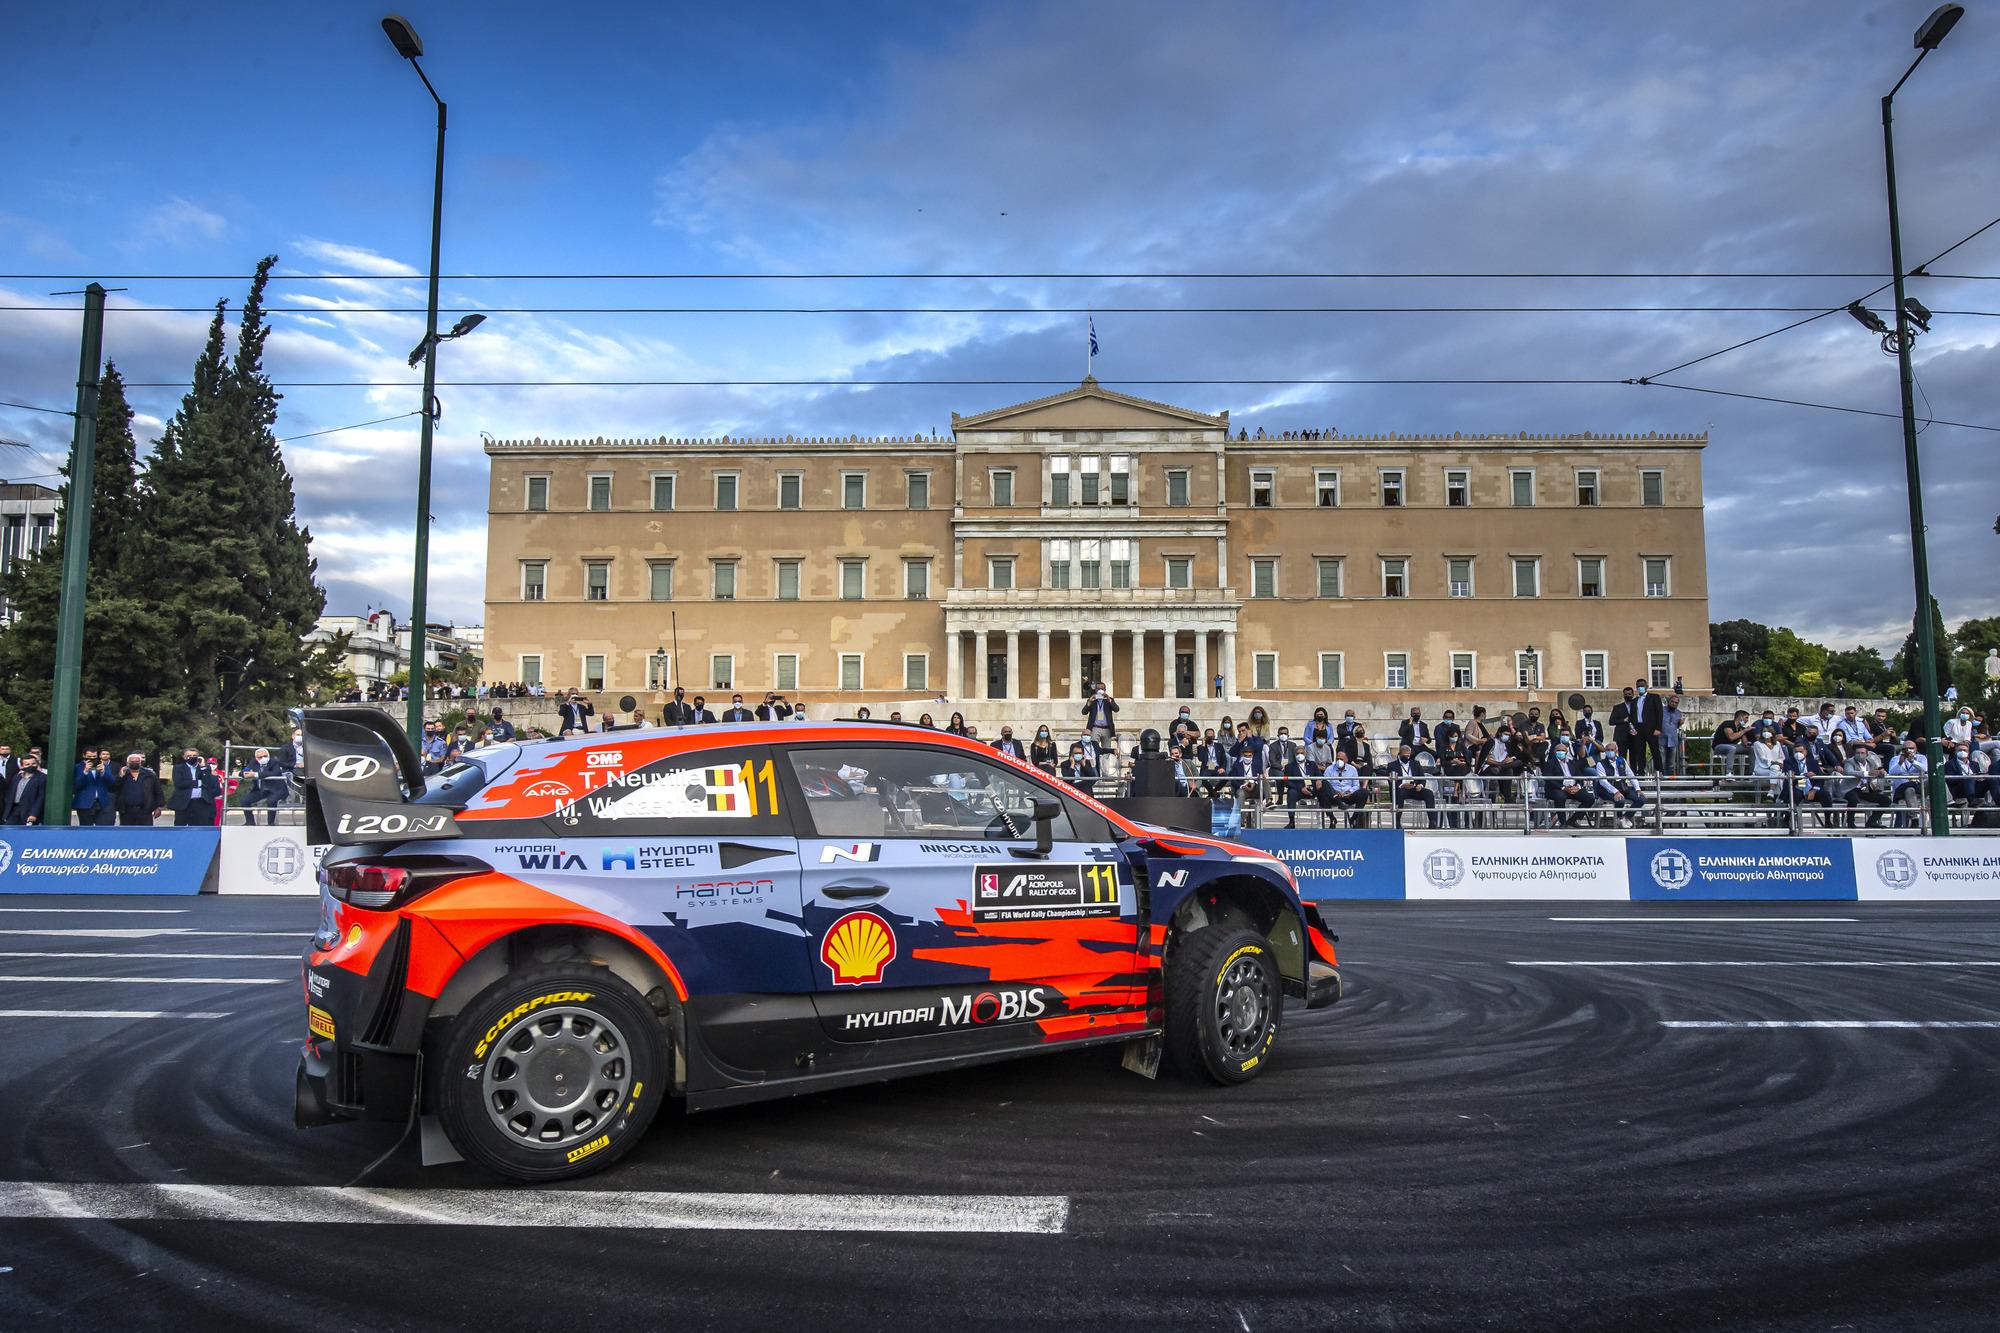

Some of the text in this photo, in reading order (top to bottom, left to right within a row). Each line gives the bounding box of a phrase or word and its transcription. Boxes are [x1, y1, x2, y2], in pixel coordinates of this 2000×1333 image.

[586, 753, 623, 766] OMP
[578, 769, 702, 789] T. Neuville
[996, 751, 1108, 813] motorsport.hyundai.com
[738, 759, 779, 816] 11
[555, 798, 582, 817] M.
[21, 848, 173, 860] ΕΛΛΗΝΙΚΗ ΔΗΜΟΚΡΑΤΙΑ
[494, 845, 556, 853] HYUNDAI
[639, 844, 714, 857] HYUNDAI
[919, 844, 1002, 855] INNOCEAN
[640, 857, 696, 869] STEEL
[1471, 856, 1605, 866] ΕΛΛΗΝΙΚΗ ΔΗΜΟΚΡΑΤΙΑ
[1699, 856, 1832, 866] ΕΛΛΗΝΙΚΗ ΔΗΜΟΚΡΑΤΙΑ
[1923, 857, 1980, 866] ΕΛΛΗΝΙΚΗ
[16, 862, 159, 876] Υφυπουργείο Αθλητισμού
[1293, 865, 1354, 879] θλητισμού
[1472, 870, 1597, 881] Υφυπουργείο Αθλητισμού
[1700, 870, 1824, 882] Υφυπουργείο Αθλητισμού
[1925, 871, 1990, 882] Υφυπουργείο
[1087, 865, 1115, 902] 11
[1029, 889, 1049, 897] RALLY
[1059, 888, 1077, 896] GODS
[688, 897, 764, 908] SYSTEMS
[1012, 911, 1030, 919] World
[1031, 911, 1045, 919] Rally
[1046, 909, 1086, 918] Championship
[939, 988, 1045, 1027] MOBIS
[846, 1007, 935, 1029] HYUNDAI
[474, 991, 593, 1059] SCORPION
